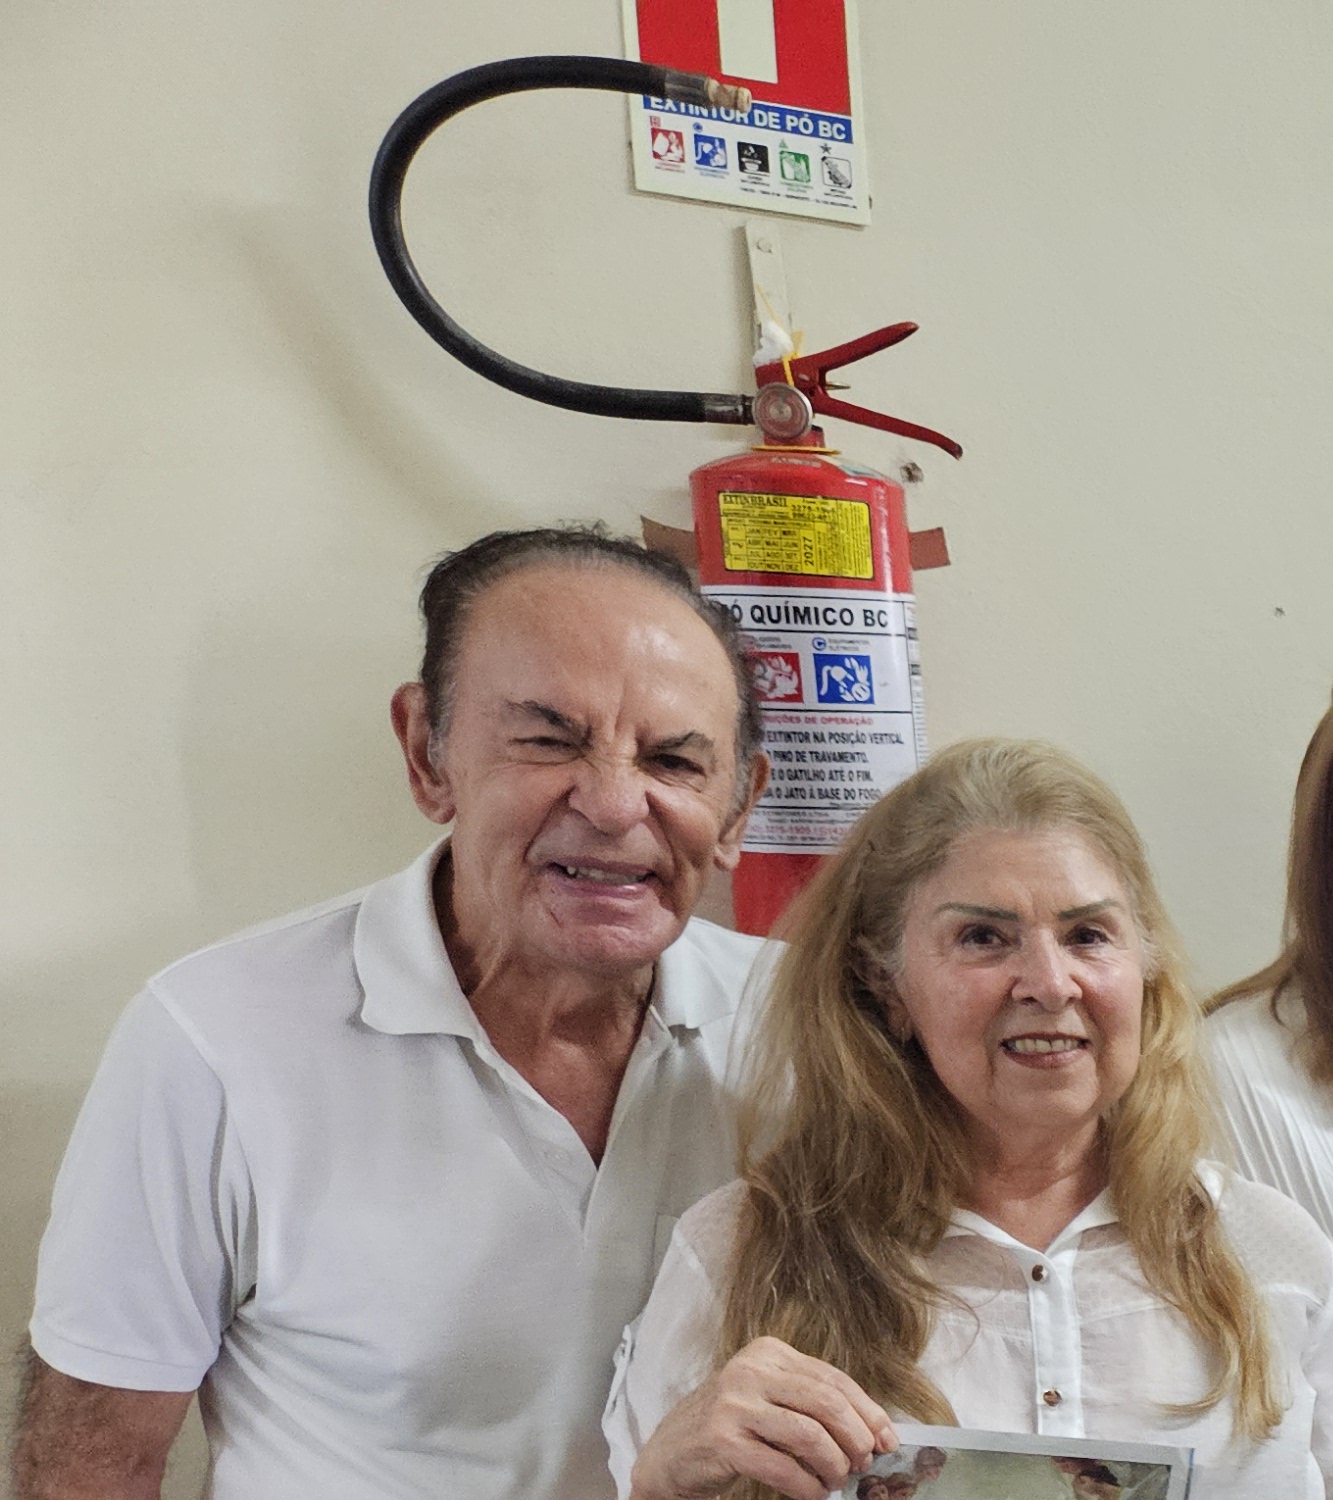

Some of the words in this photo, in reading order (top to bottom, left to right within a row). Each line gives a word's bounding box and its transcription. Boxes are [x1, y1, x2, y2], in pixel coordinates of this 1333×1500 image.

[753, 110, 782, 130] DE
[785, 113, 814, 135] PÓ
[818, 119, 846, 140] BC
[803, 536, 815, 567] 2027
[750, 600, 855, 627] QUÍMICO
[863, 608, 889, 628] BC
[766, 730, 811, 744] EXTINTOR
[812, 731, 826, 744] NA
[828, 730, 867, 747] POSIÇÃO
[795, 750, 808, 763] DE
[786, 768, 826, 782] GATILHO
[828, 766, 845, 782] ATÉ
[784, 787, 807, 800] JATO
[817, 787, 840, 801] BASE
[843, 788, 856, 801] DO
